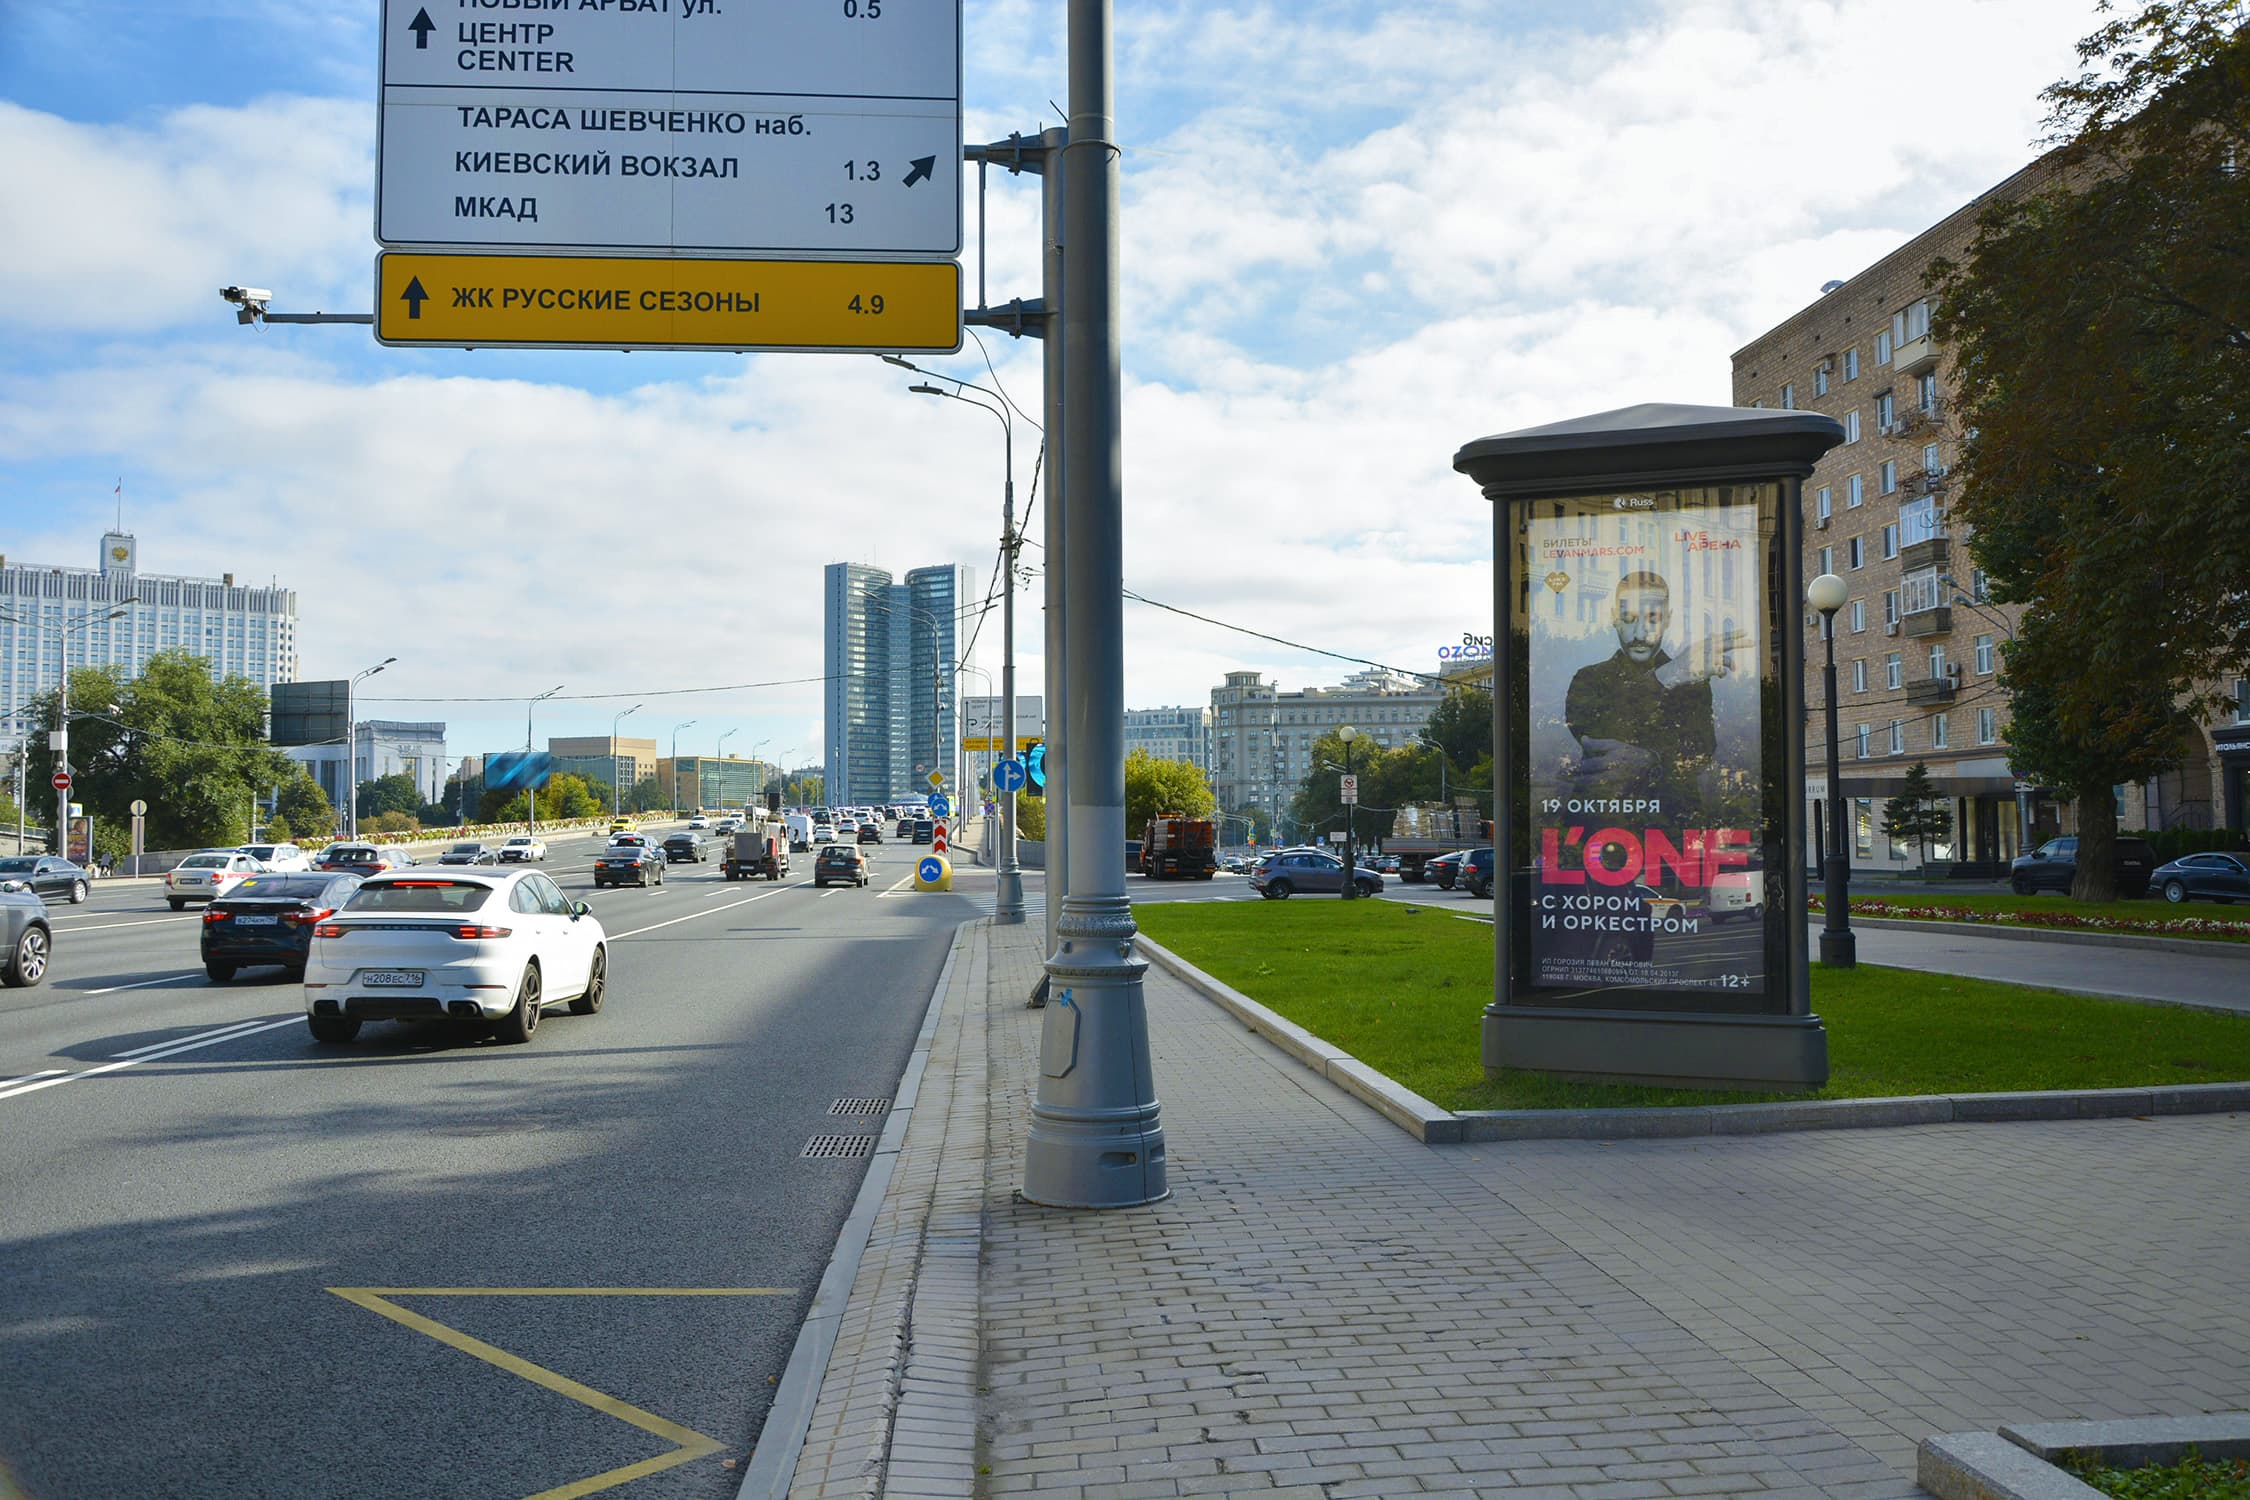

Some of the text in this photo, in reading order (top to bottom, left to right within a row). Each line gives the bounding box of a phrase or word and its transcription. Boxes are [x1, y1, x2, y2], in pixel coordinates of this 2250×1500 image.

[844, 0, 882, 19] 0.5
[458, 23, 554, 46] ЦЕНТР
[457, 50, 575, 72] CENTER
[457, 107, 812, 136] ТАРАСА ШЕВЧЕНКО наб.
[455, 150, 738, 179] КИЕВСКИЙ ВОКЗАЛ
[843, 161, 881, 181] 1.3
[455, 197, 538, 222] МКАД
[825, 204, 854, 224] 13
[452, 288, 760, 313] ЖК РУССКИЕ СЕЗОНЫ
[847, 295, 885, 315] 4.9
[1630, 498, 1654, 507] Russ
[1543, 537, 1592, 548] БИЛЕТЫ
[1675, 531, 1708, 543] LIVE
[1688, 539, 1742, 552] АРЕНА
[1543, 546, 1645, 559] LEVANMARS.COM
[1542, 799, 1661, 814] 19 ОКТЯБРЯ
[1541, 895, 1641, 912] С ХОРОМ
[1541, 915, 1699, 934] И ОРКЕСТРОМ
[1720, 973, 1751, 989] 12+
